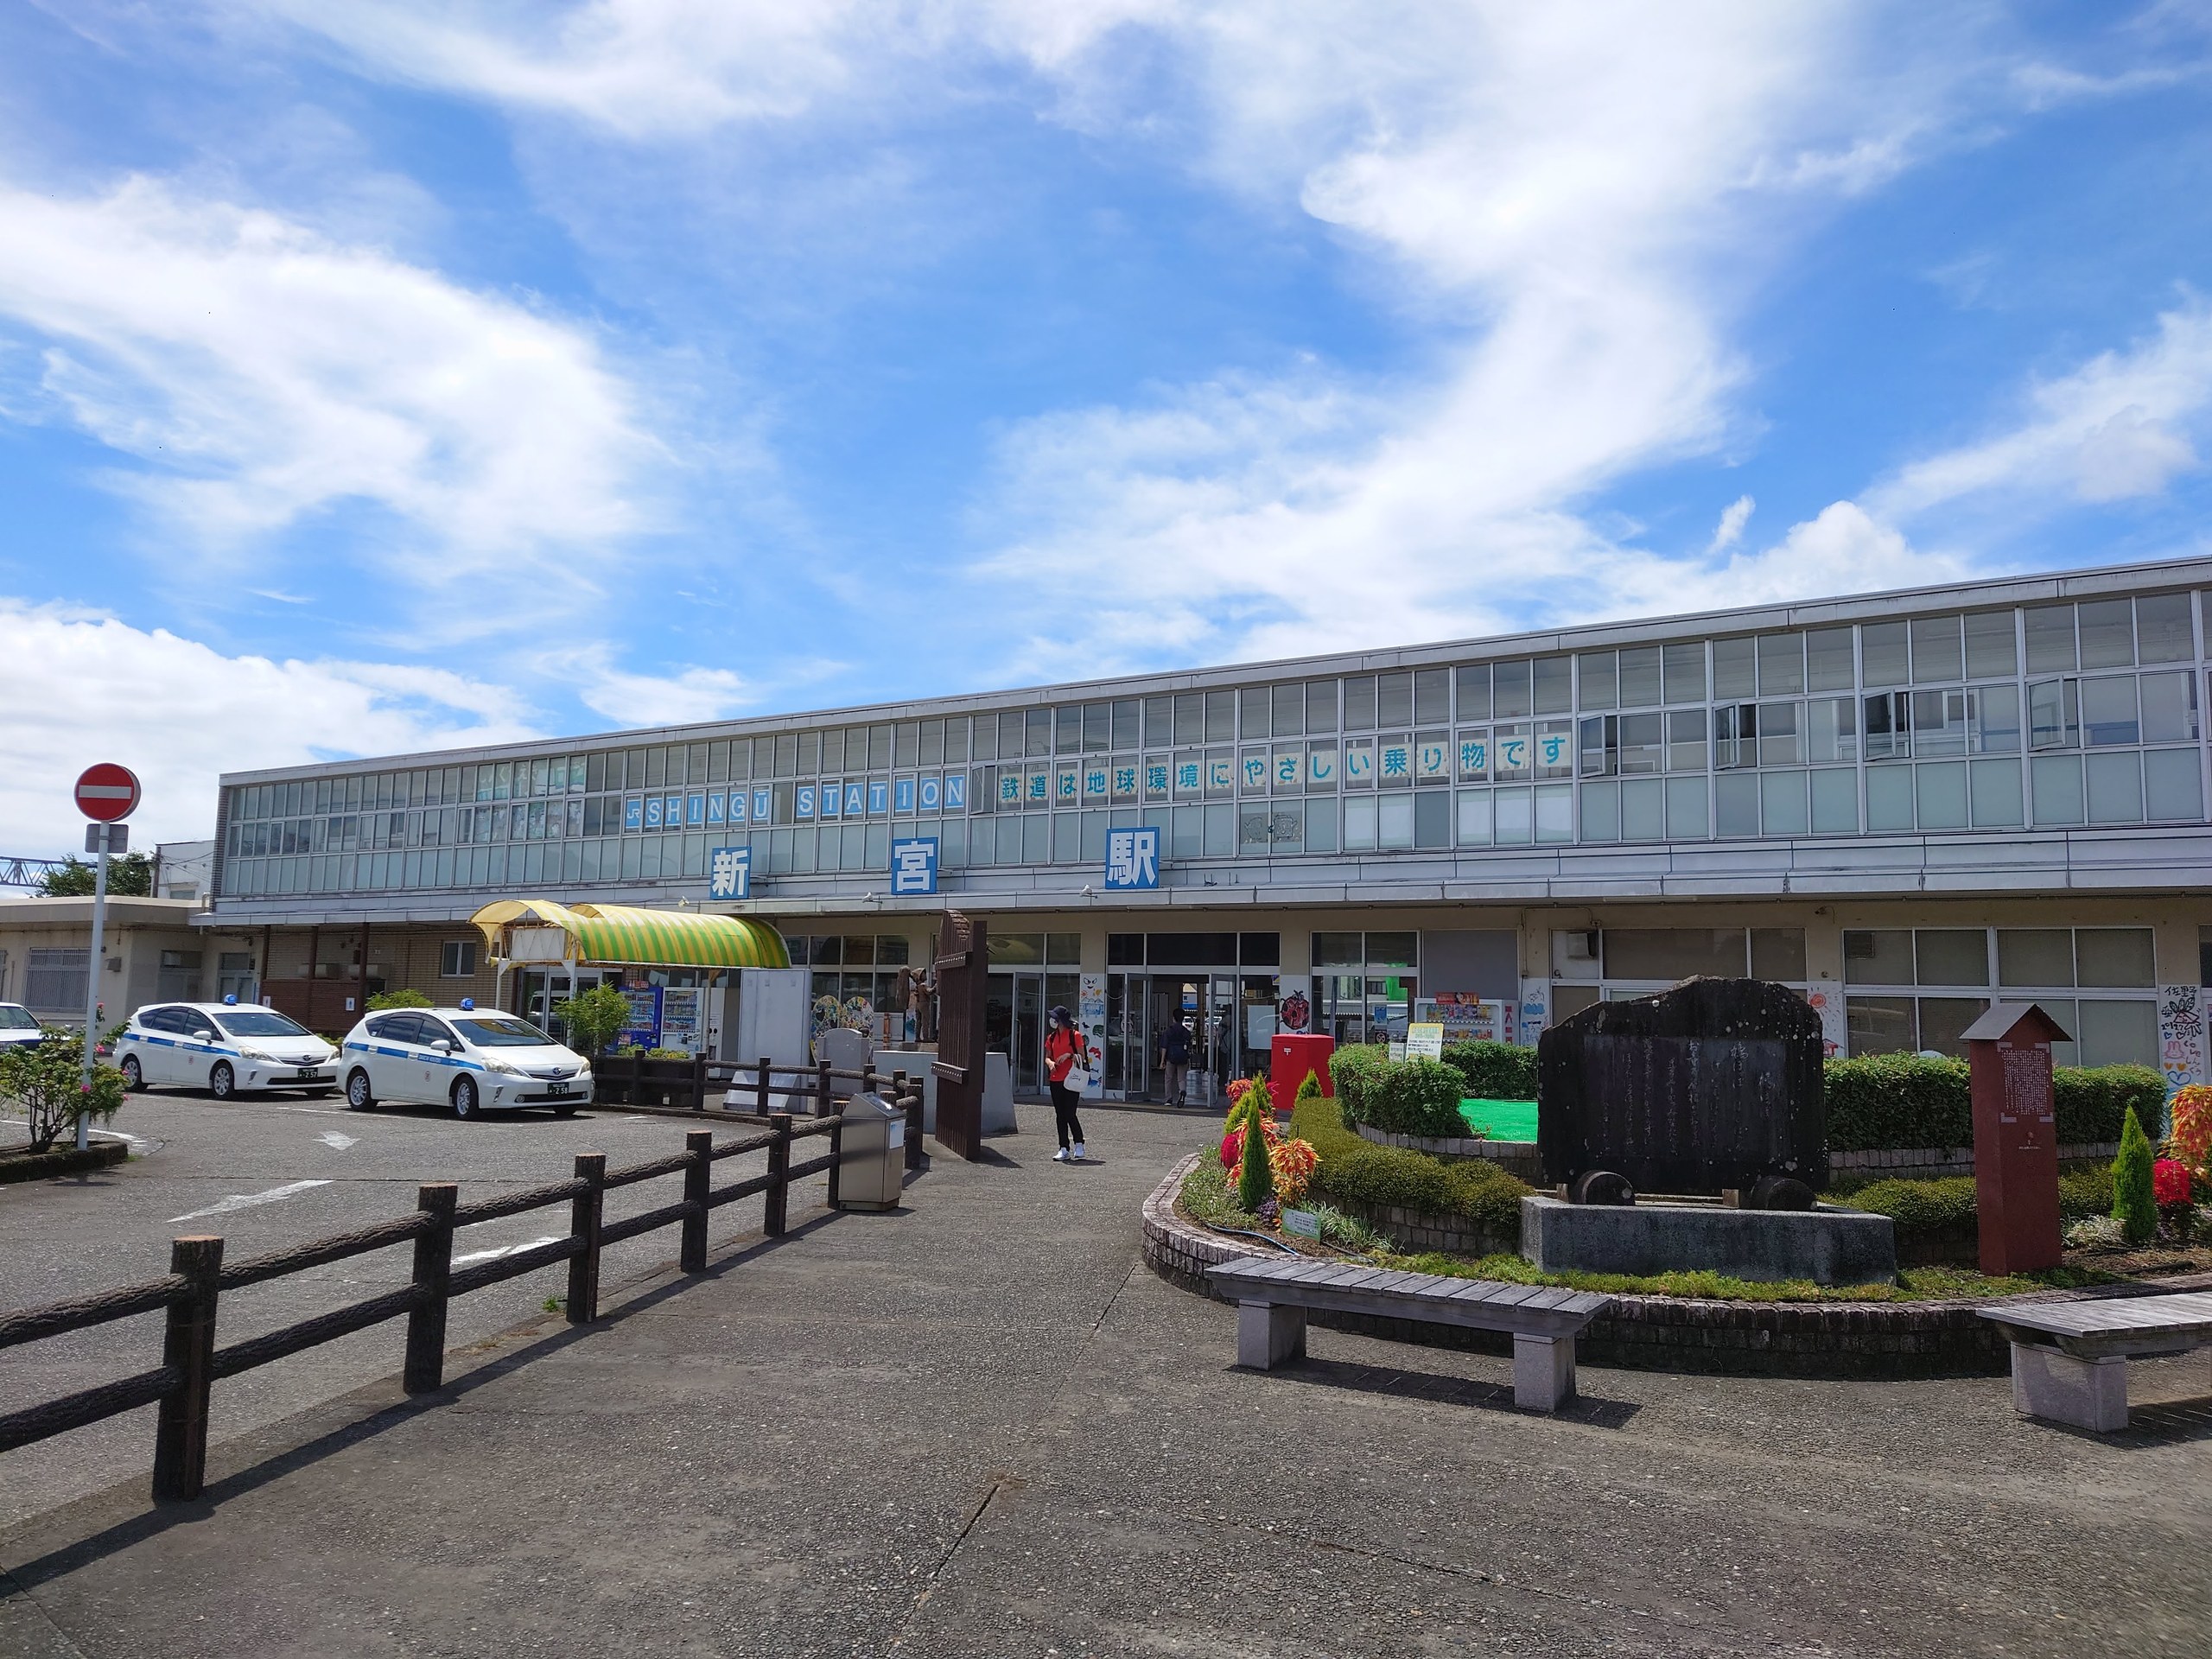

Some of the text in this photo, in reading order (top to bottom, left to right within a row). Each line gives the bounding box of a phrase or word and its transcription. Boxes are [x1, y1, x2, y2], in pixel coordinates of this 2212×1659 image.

[1001, 737, 1566, 799] 鉄道は地球環境にやさしい乗り物です
[627, 808, 640, 820] JR
[799, 779, 963, 813] STATION
